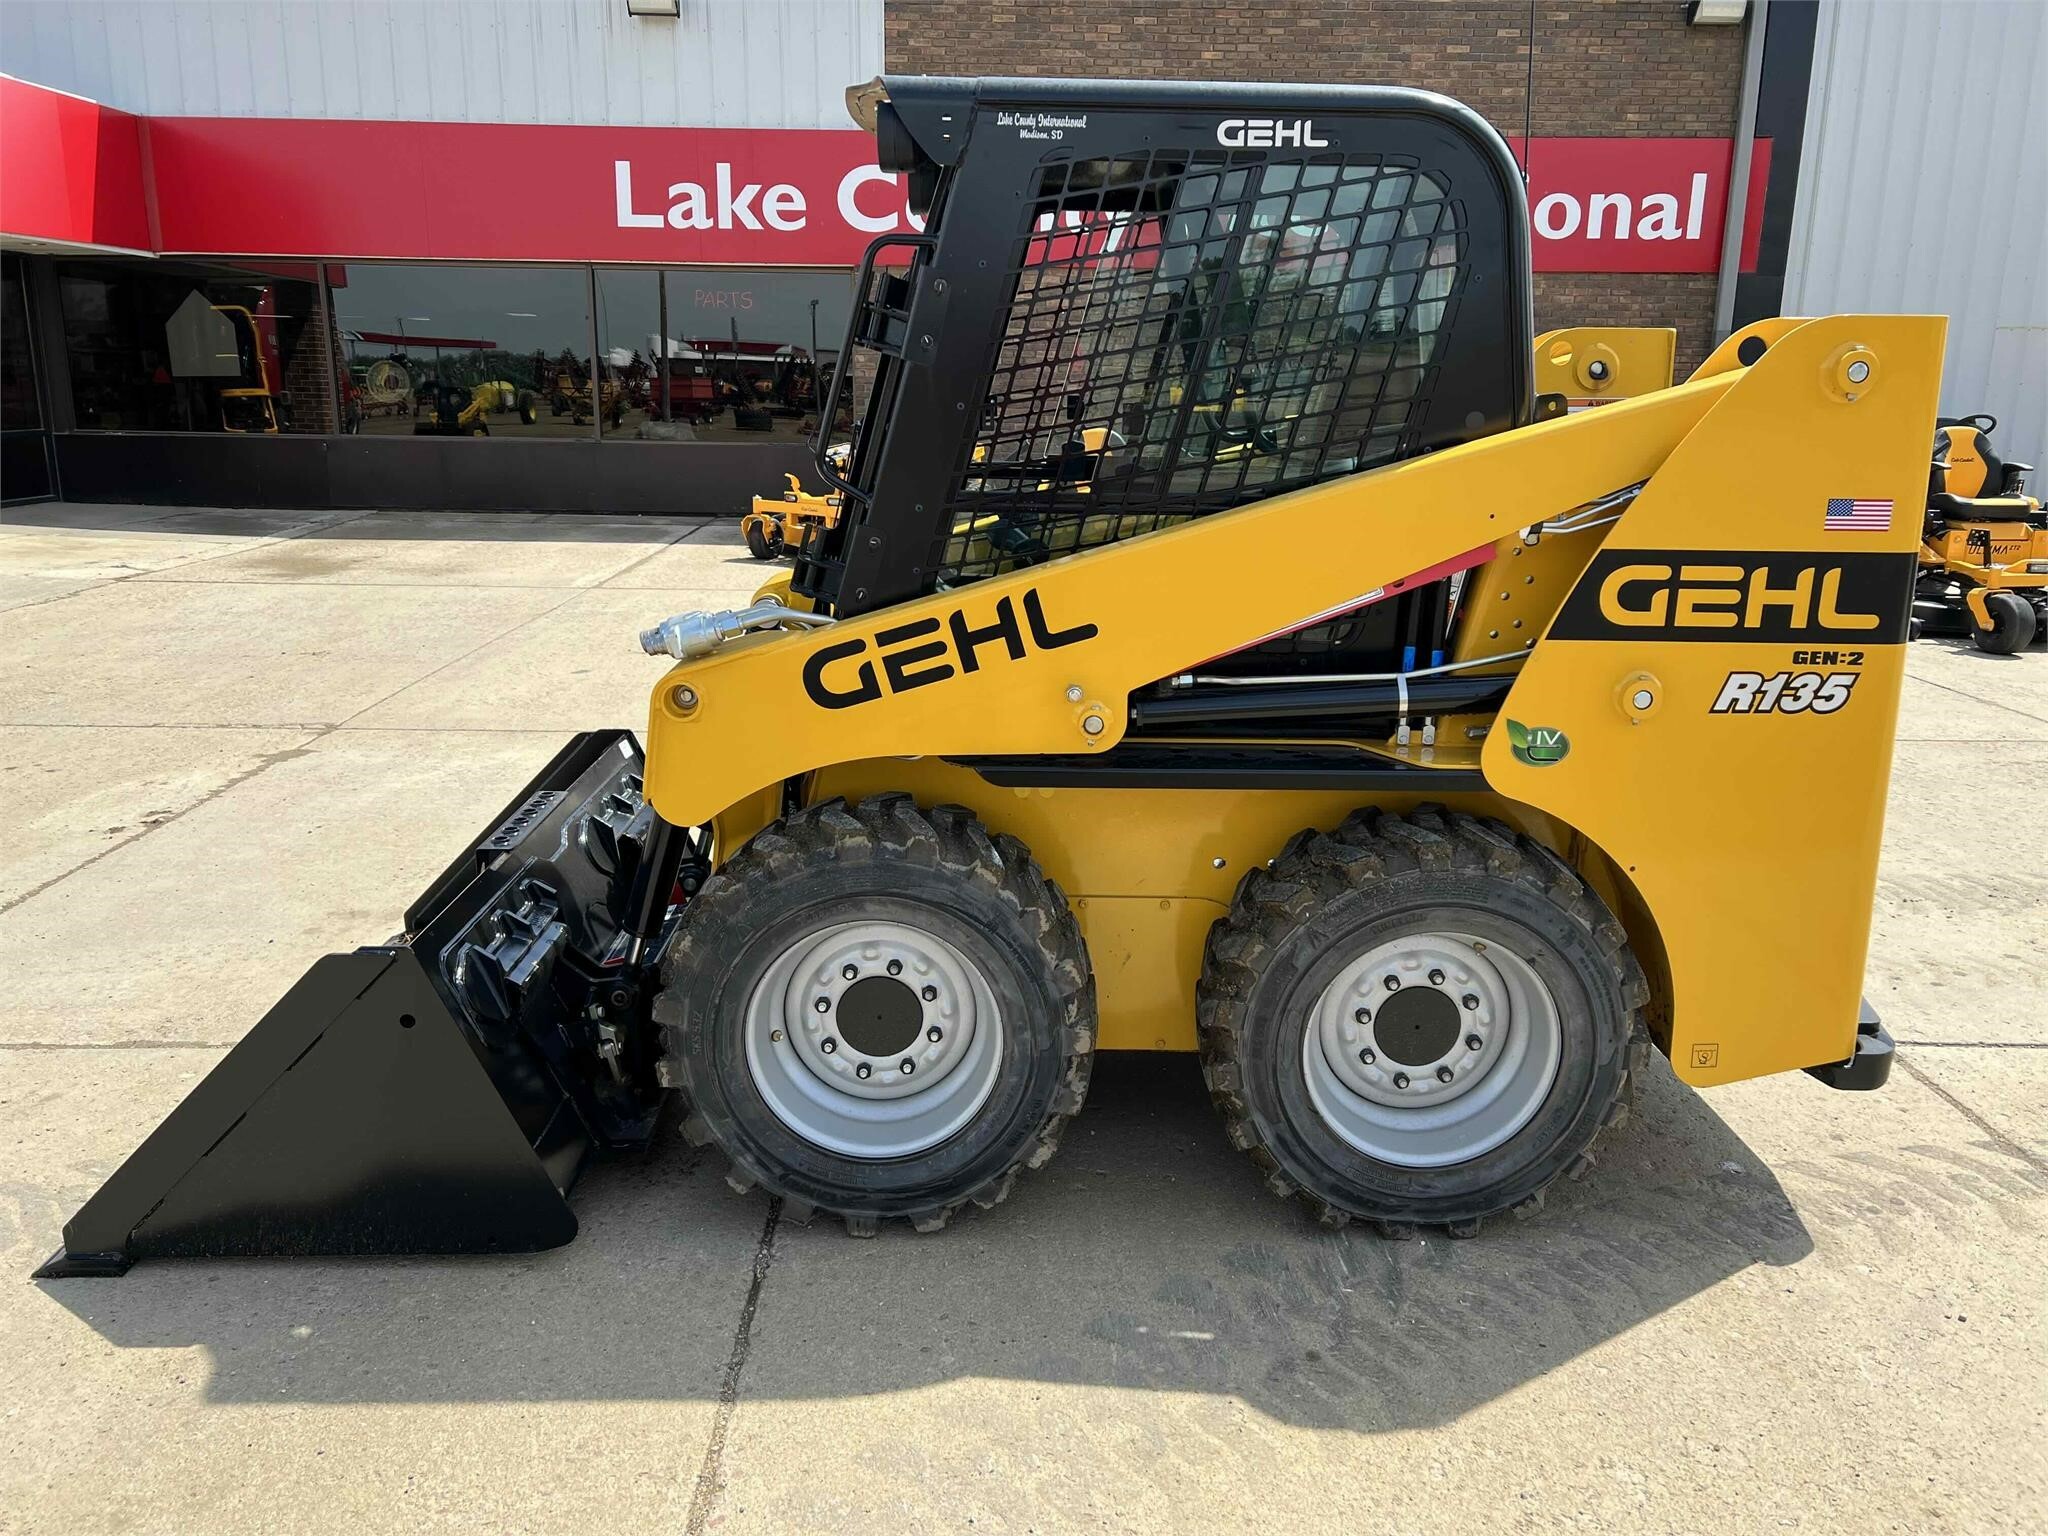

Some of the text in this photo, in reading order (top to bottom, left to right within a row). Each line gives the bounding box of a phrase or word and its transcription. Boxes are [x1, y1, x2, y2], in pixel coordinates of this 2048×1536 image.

[997, 112, 1087, 128] Lake County International
[1051, 129, 1063, 140] SD
[1217, 119, 1328, 147] GEHL
[614, 160, 807, 231] Lake
[694, 289, 753, 310] PARTS
[1599, 565, 1881, 630] GEHL
[802, 587, 1099, 710] GEHL
[1708, 671, 1861, 714] R135
